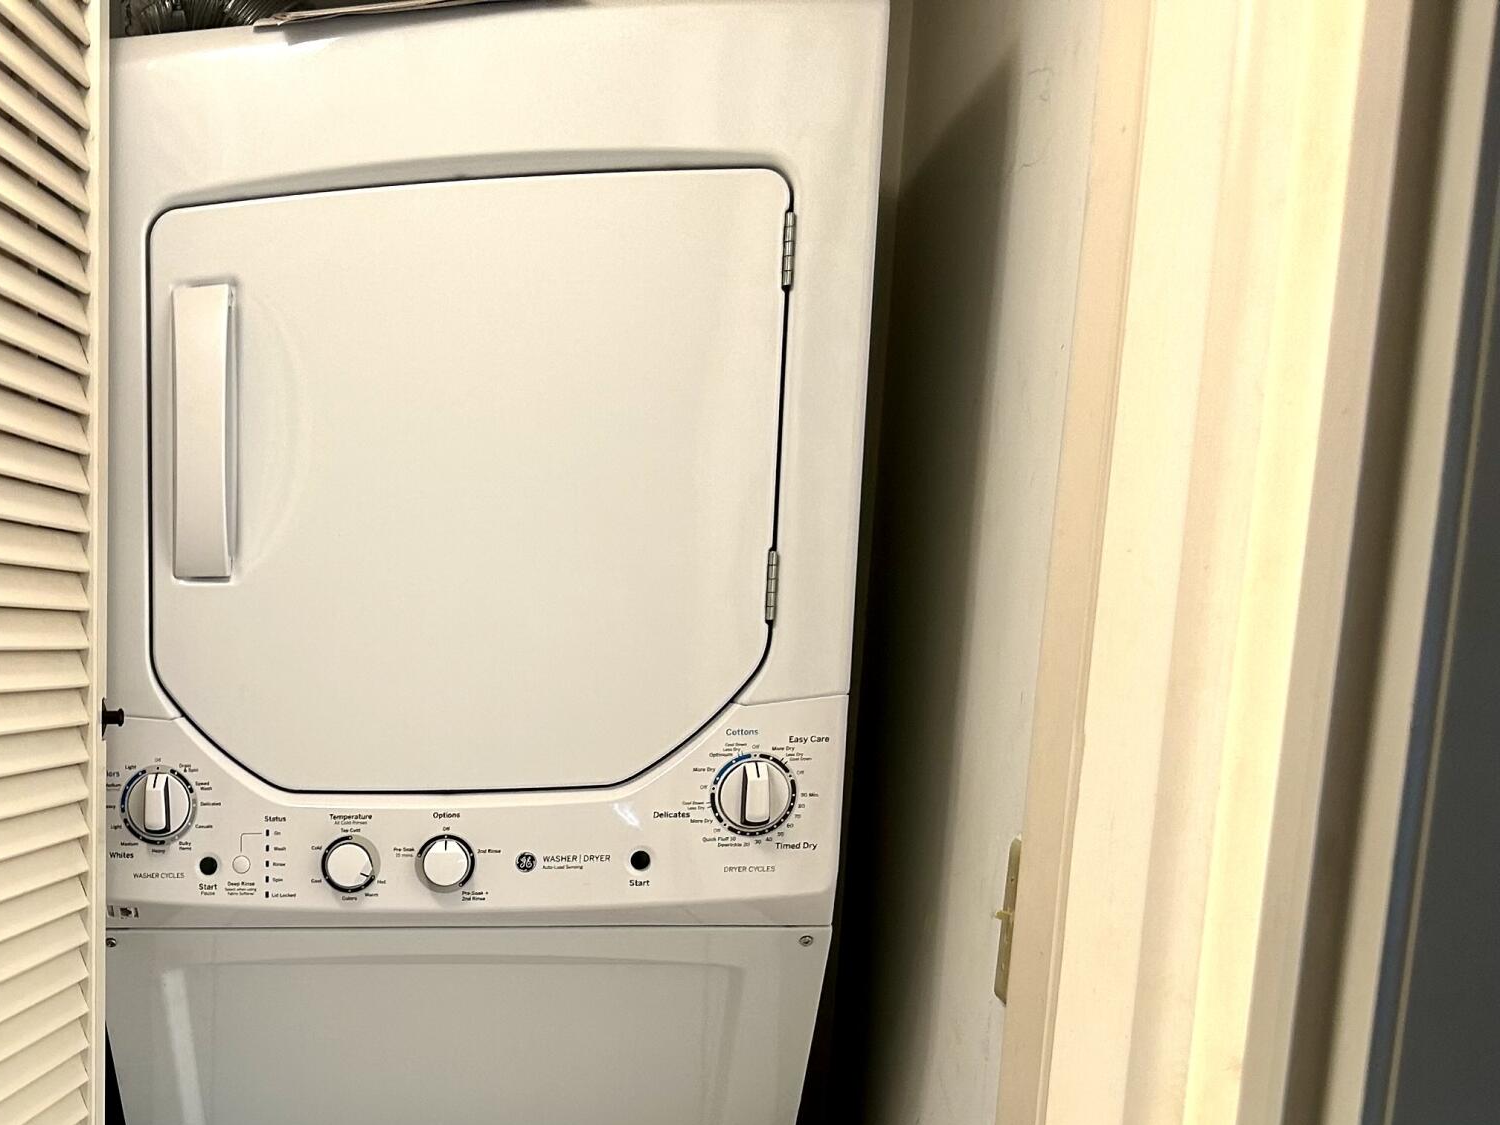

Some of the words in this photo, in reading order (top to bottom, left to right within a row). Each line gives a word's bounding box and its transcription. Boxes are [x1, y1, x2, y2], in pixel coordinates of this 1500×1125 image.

[725, 728, 759, 737] Cottons
[789, 736, 807, 745] Easy
[329, 813, 373, 822] Temperature
[432, 811, 461, 820] Options
[653, 811, 691, 820] Delicates
[775, 842, 801, 850] Timed
[802, 842, 818, 851] Dry
[109, 851, 134, 859] Whites
[542, 855, 578, 863] WASHER
[583, 854, 611, 862] DRYER
[629, 879, 651, 887] Start
